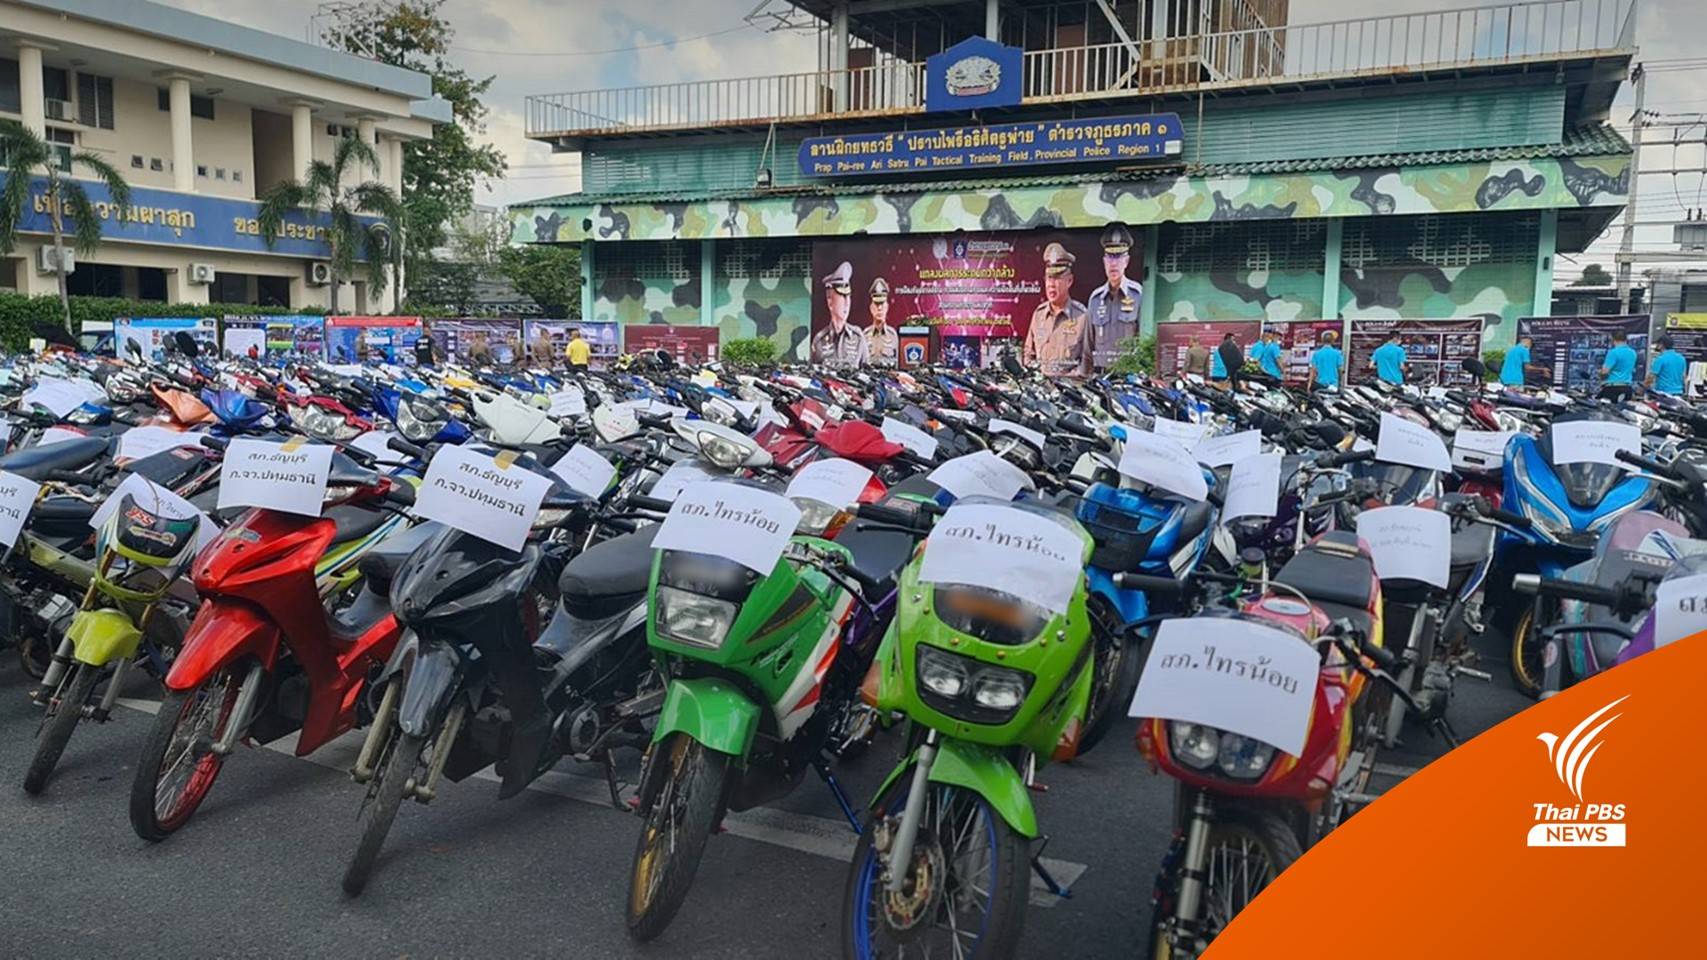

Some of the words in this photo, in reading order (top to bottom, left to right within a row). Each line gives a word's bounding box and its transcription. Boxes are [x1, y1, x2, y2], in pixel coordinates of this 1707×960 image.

[814, 162, 832, 173] Prap
[932, 154, 963, 166] Tactical
[969, 152, 1002, 165] Training
[1083, 145, 1111, 157] Police
[1118, 143, 1149, 156] Region
[1155, 143, 1160, 153] 1
[680, 500, 780, 534] สภ.ไทรน้อย
[1160, 645, 1299, 695] สภ.ไทรน้อย
